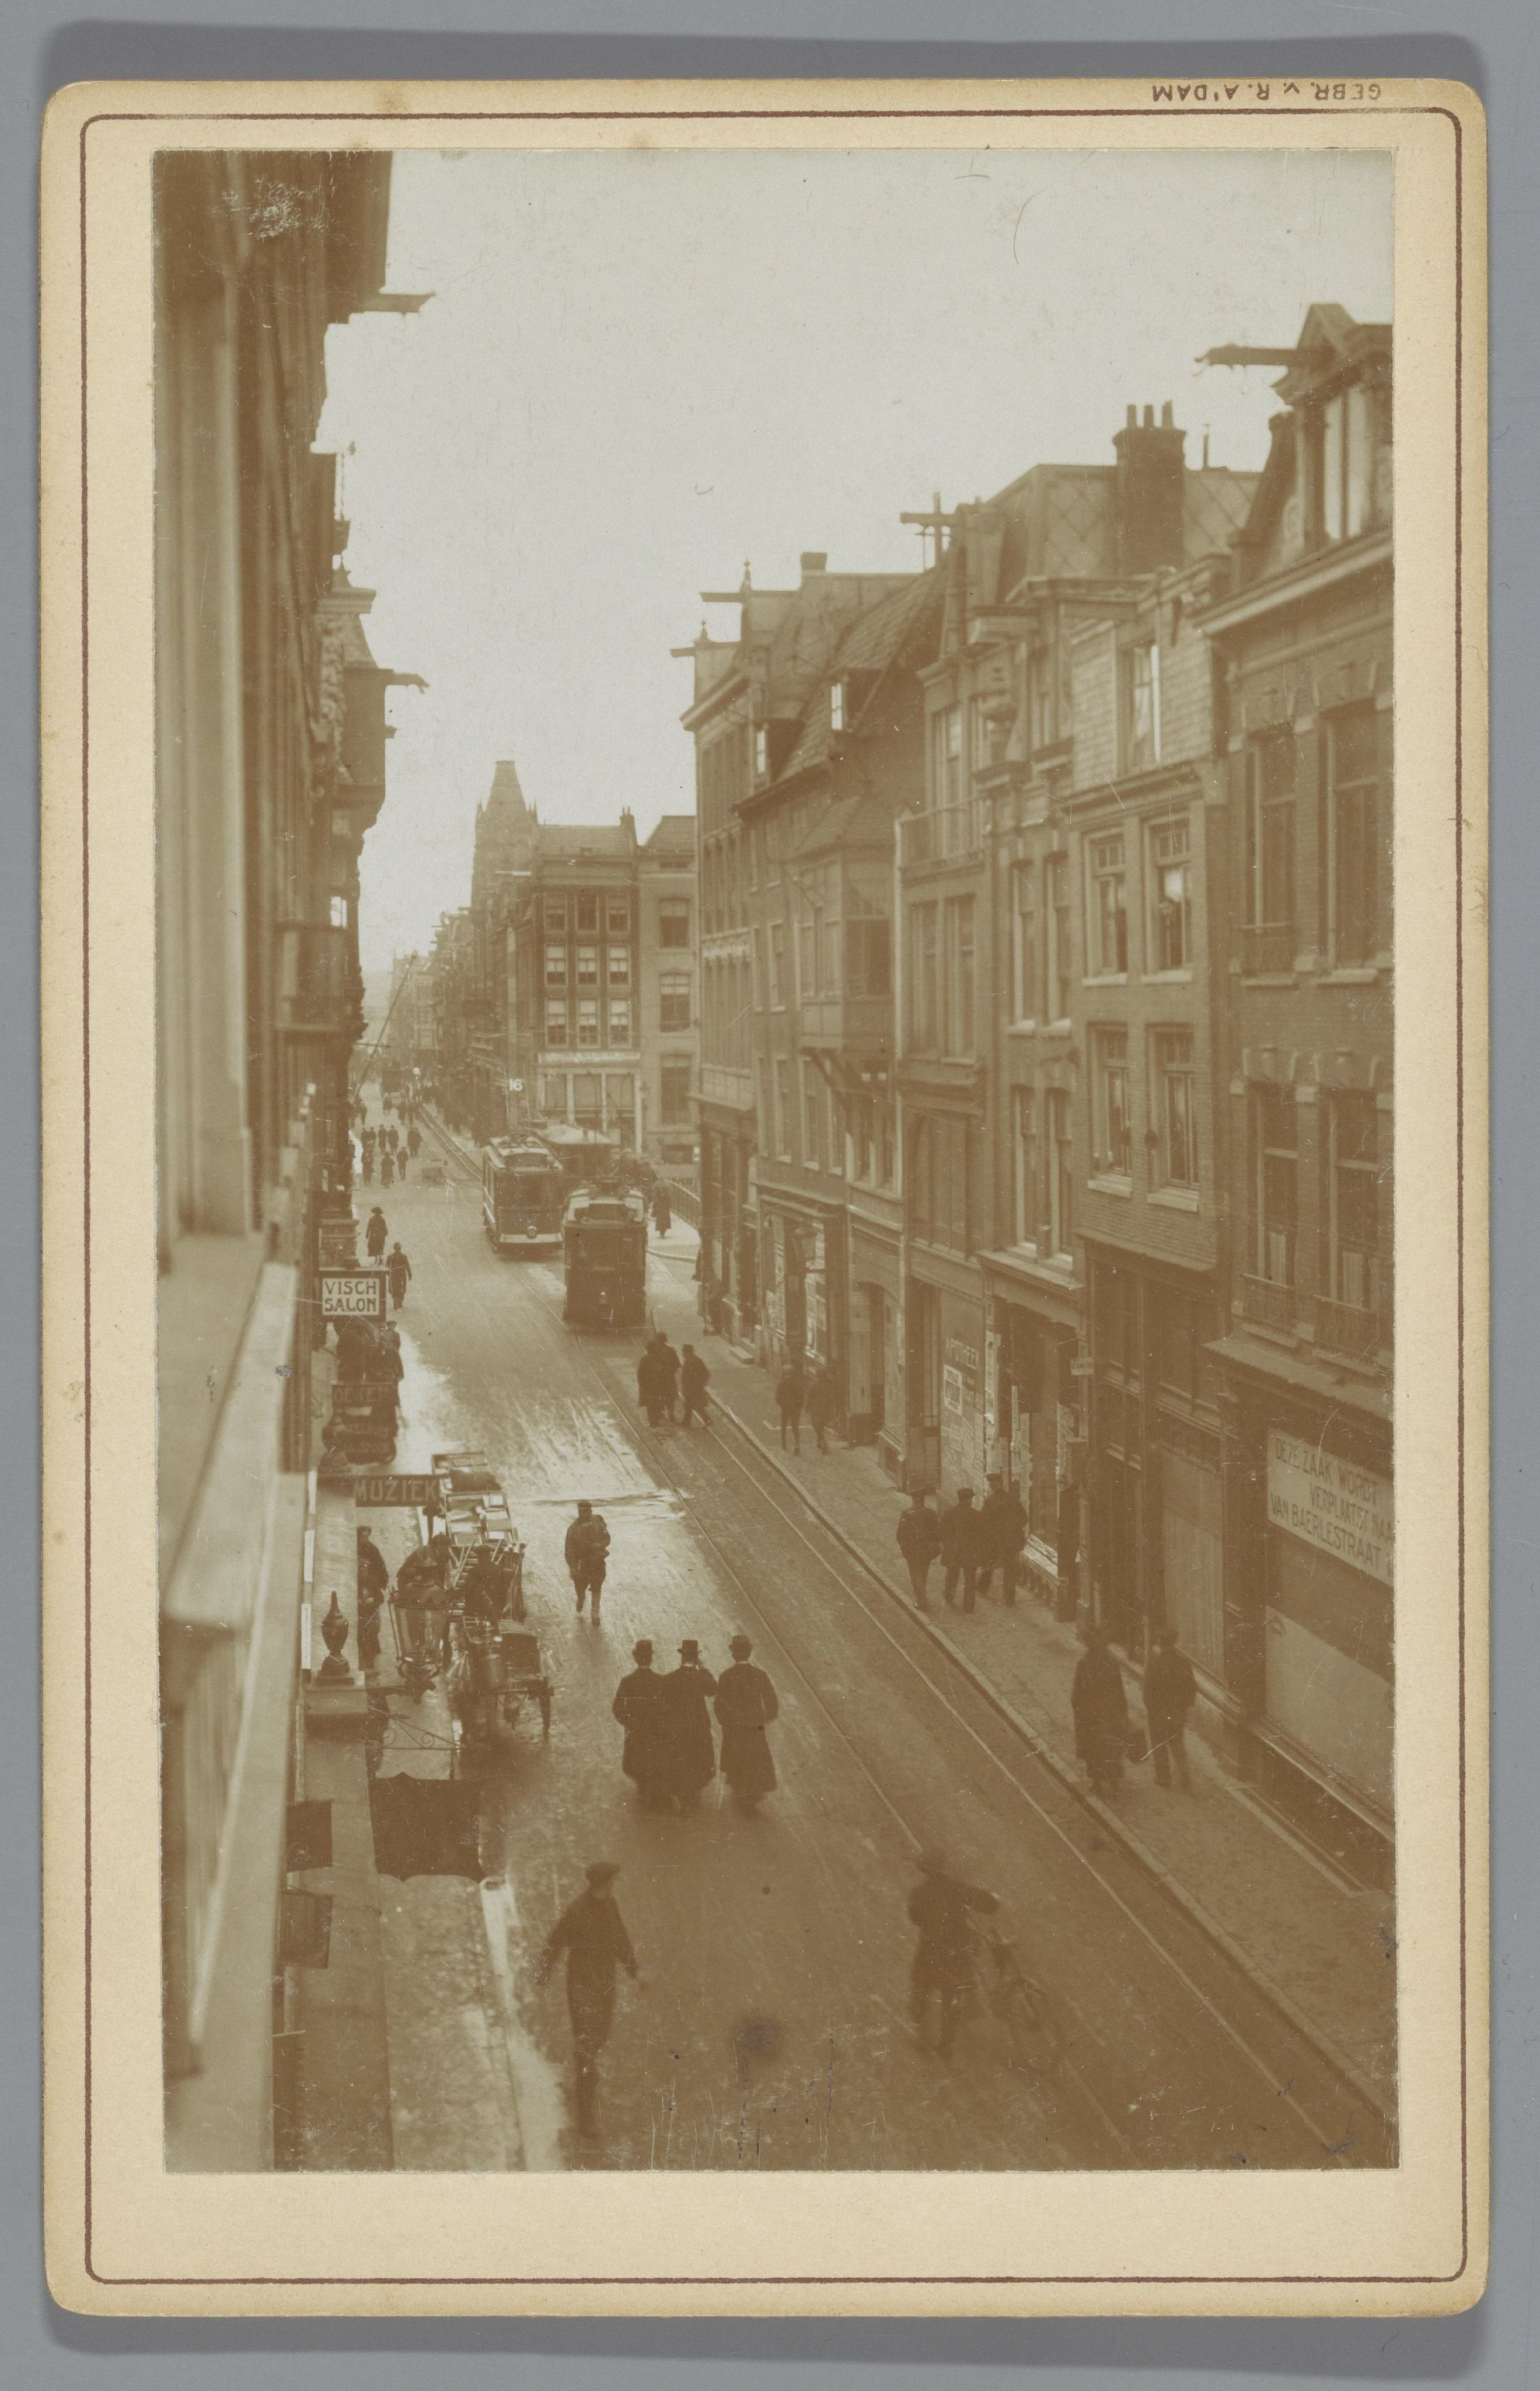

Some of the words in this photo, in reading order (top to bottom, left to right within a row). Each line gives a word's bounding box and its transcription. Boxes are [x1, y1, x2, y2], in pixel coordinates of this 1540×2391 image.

[1152, 83, 1239, 102] A'DAM
[1248, 82, 1270, 101] R.
[1310, 82, 1381, 101] GEBR.
[509, 1078, 523, 1091] 16
[324, 1281, 376, 1295] VISCH
[324, 1298, 376, 1312] SALON
[945, 1336, 980, 1373] APOTHEEK
[1275, 1438, 1300, 1469] DEZE
[1303, 1449, 1333, 1486] ZAAK
[1338, 1465, 1378, 1507] WORDT
[354, 1478, 438, 1503] MUZIEK
[1270, 1491, 1288, 1523] VAN
[1292, 1504, 1382, 1570] BAERLESTRAAT
